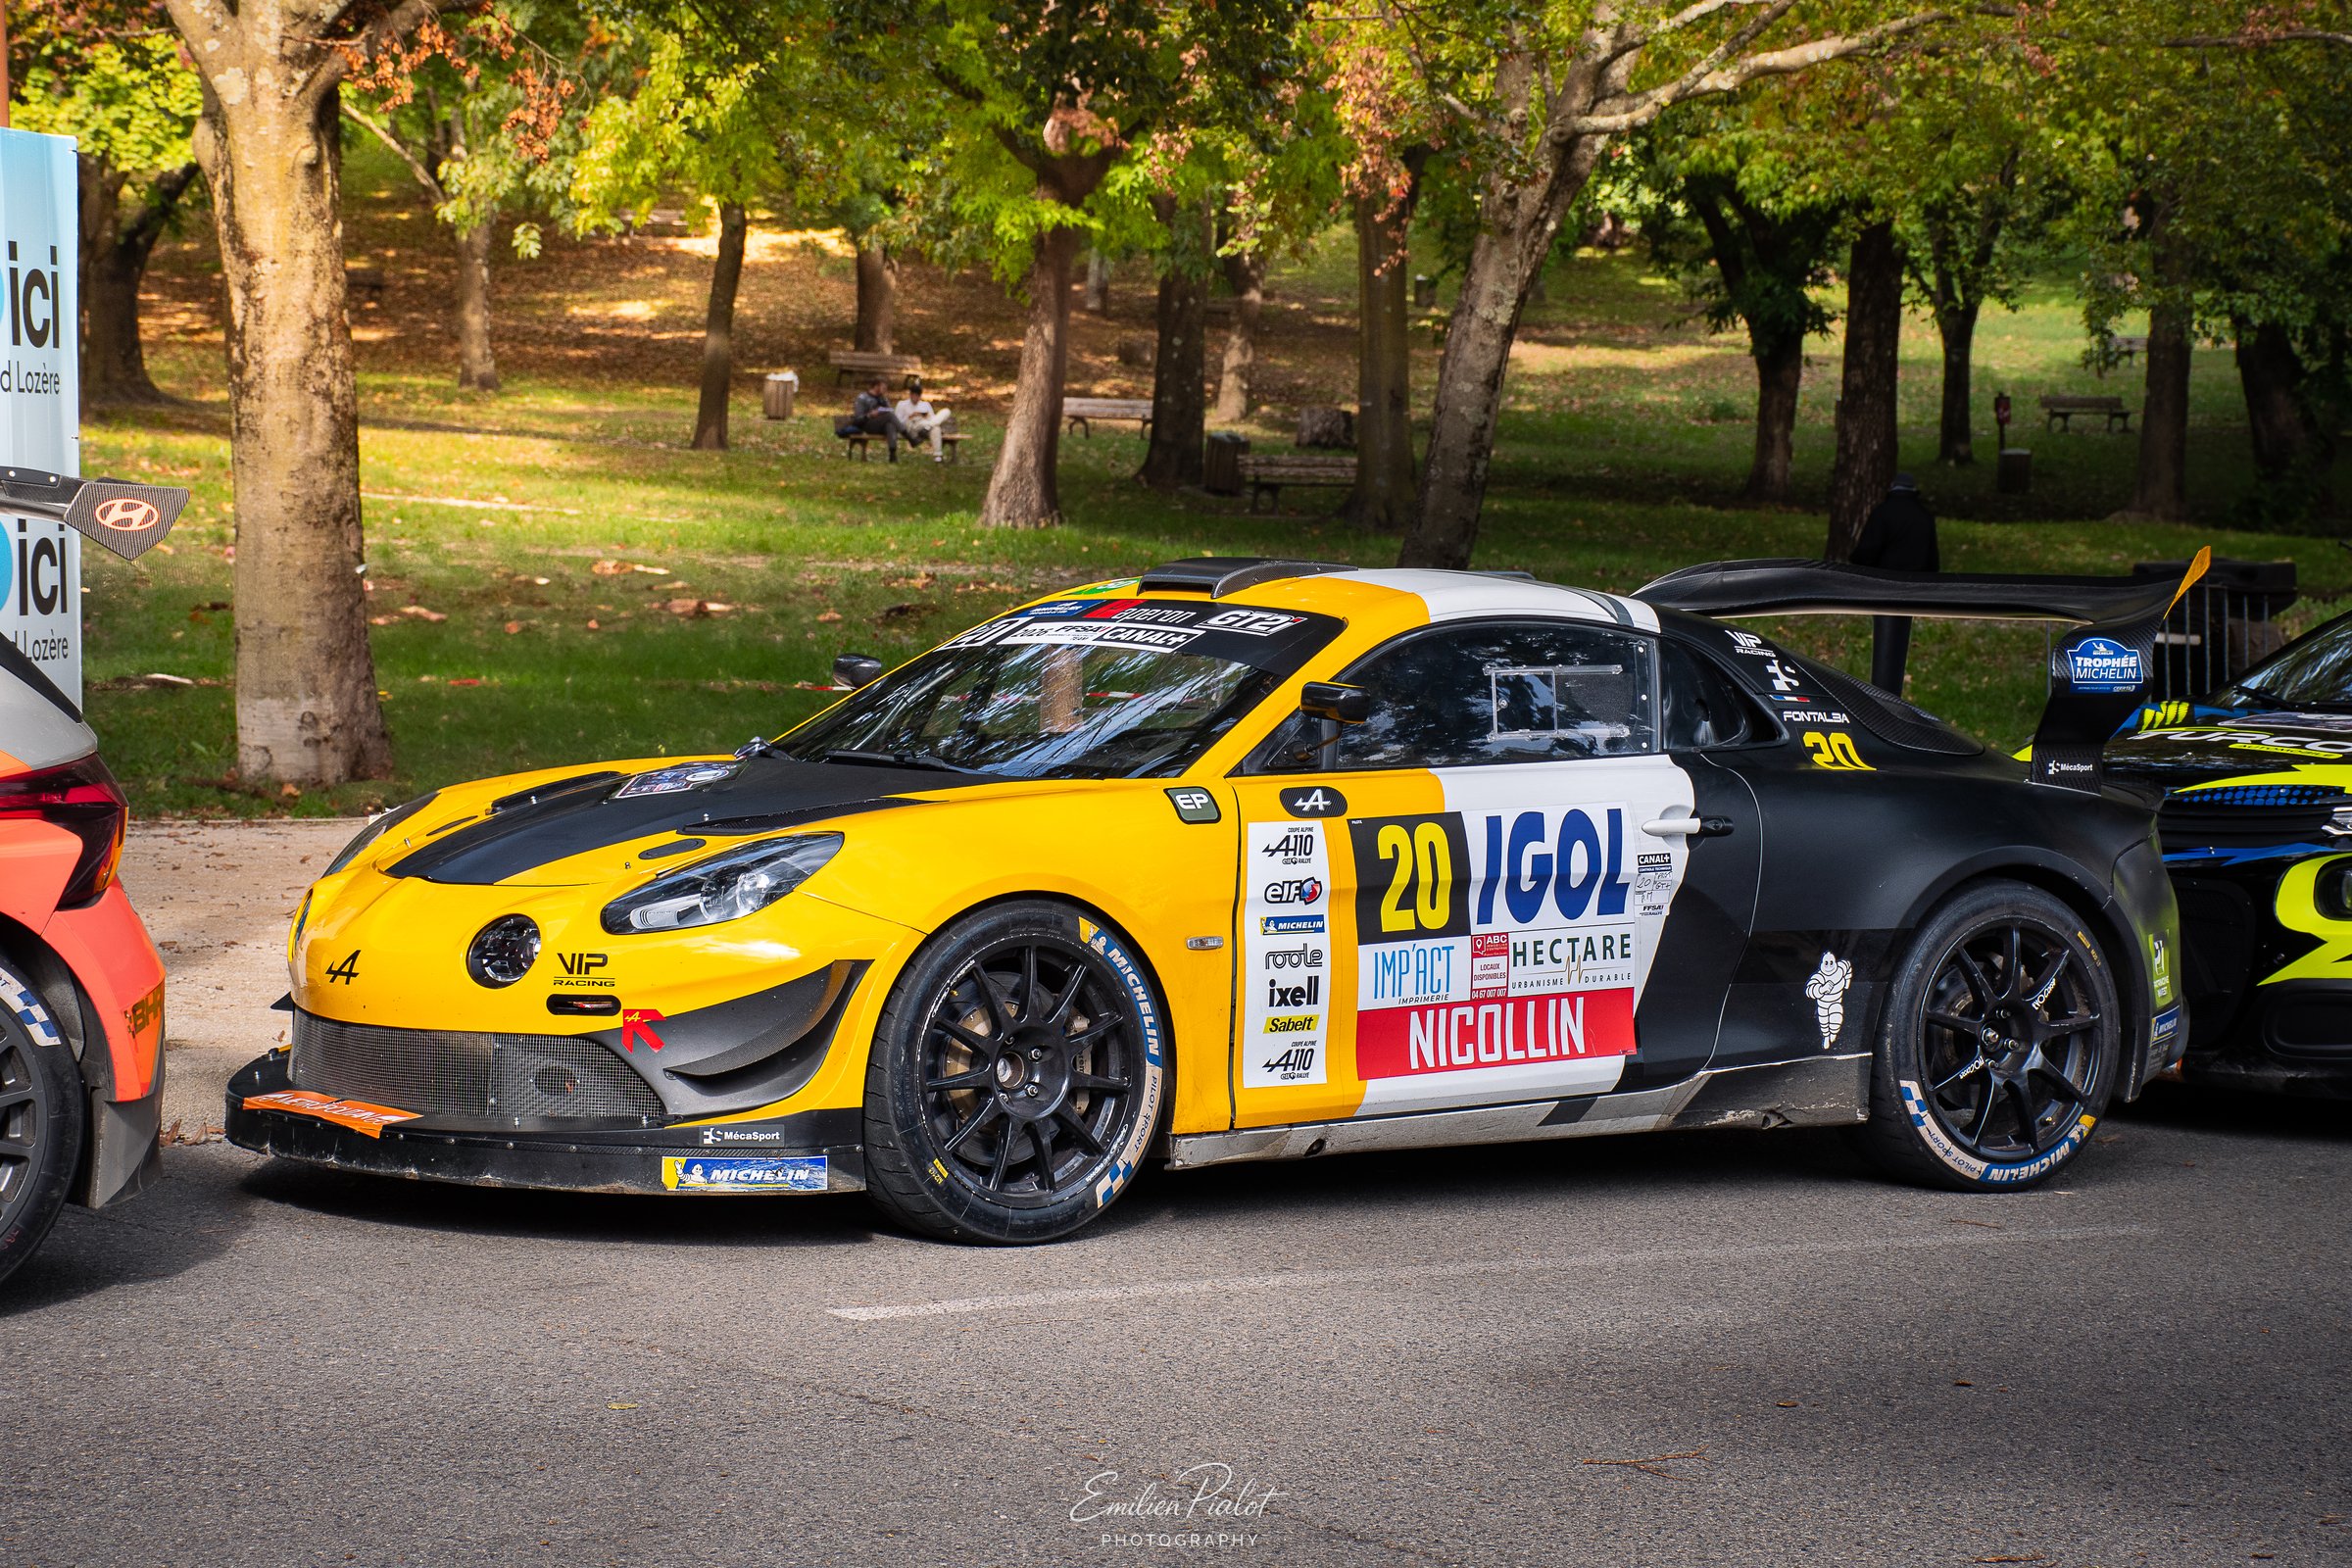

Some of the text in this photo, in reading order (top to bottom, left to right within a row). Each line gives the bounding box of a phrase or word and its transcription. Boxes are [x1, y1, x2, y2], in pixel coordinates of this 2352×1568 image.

[8, 240, 60, 349] ici
[17, 361, 60, 395] Lozère
[18, 517, 68, 616] ici
[24, 628, 69, 662] Lozère
[1102, 625, 1188, 647] CANAL+
[1725, 630, 1762, 648] VIP
[1736, 648, 1777, 658] RACING
[2075, 655, 2137, 667] TROPHÉE
[2076, 667, 2137, 679] MICHELIN
[1783, 710, 1850, 724] FONTALBA
[1802, 731, 1878, 771] 20
[2126, 730, 2352, 754] TURCO
[2061, 763, 2093, 773] MécaSport
[1175, 792, 1209, 810] EP
[1476, 808, 1632, 925] IGOL
[1639, 854, 1671, 864] CANAL+
[1377, 821, 1453, 933] 20
[1637, 877, 1652, 889] 20
[1265, 880, 1302, 904] elf
[1277, 919, 1324, 930] MICHELIN
[1486, 934, 1507, 945] ABC
[1512, 933, 1632, 967] HECTARE
[557, 953, 609, 975] VIP
[1480, 962, 1500, 971] LOCAUX
[1473, 971, 1506, 981] DISPONIBLES
[1511, 972, 1632, 990] URBANISME DURABLE
[1268, 975, 1320, 1007] ixell
[1397, 993, 1449, 1005] IMPRIMERIE
[1472, 991, 1479, 1000] 04
[1480, 990, 1487, 999] 67
[1106, 947, 1160, 1056] MICHELIN
[1268, 1016, 1314, 1033] Sabelt
[1409, 996, 1586, 1070] NICOLLIN
[1133, 1074, 1157, 1155] PILOT SPORT
[723, 1131, 781, 1142] MécaSport
[1928, 1131, 1978, 1173] PILOT SPORT
[1986, 1140, 2071, 1182] MICHELIN
[710, 1167, 810, 1182] MICHELIN
